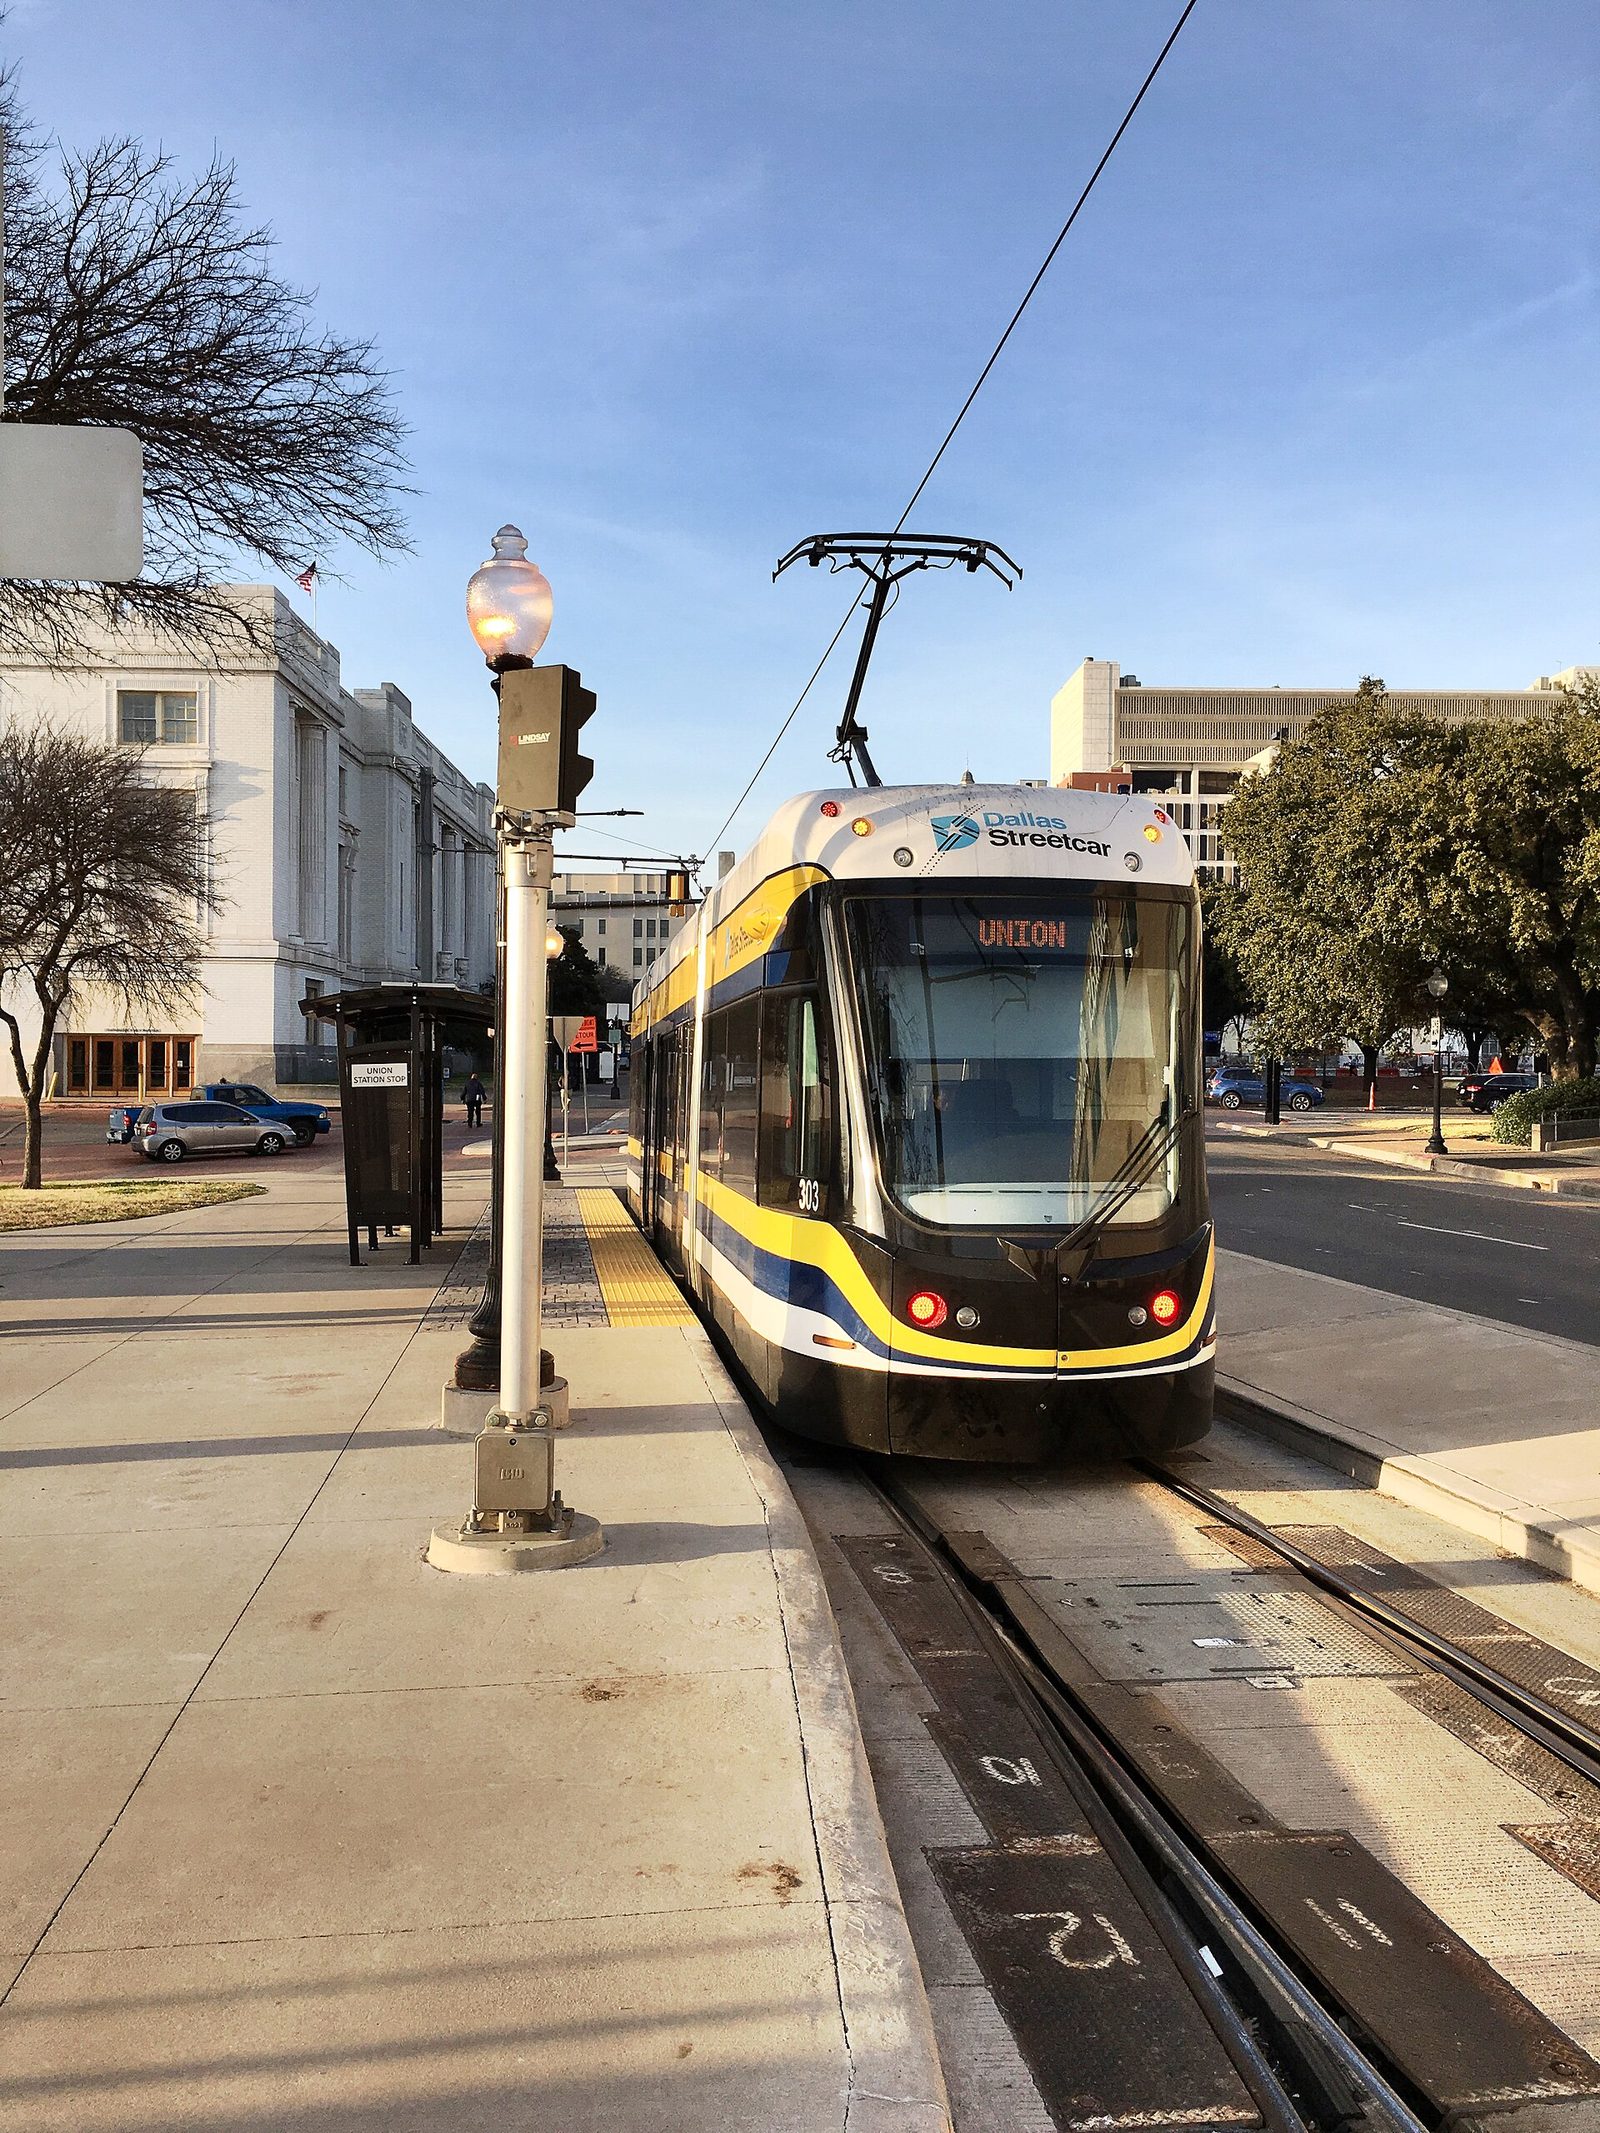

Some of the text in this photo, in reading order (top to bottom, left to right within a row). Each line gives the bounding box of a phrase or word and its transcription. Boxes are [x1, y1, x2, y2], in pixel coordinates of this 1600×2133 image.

[518, 732, 551, 743] LINDSAY
[982, 812, 1068, 831] Dallas
[988, 829, 1112, 857] Streetcar
[979, 919, 1066, 948] UNION
[353, 1075, 406, 1084] STATION STOP
[366, 1066, 393, 1075] UNION
[798, 1178, 819, 1212] 303
